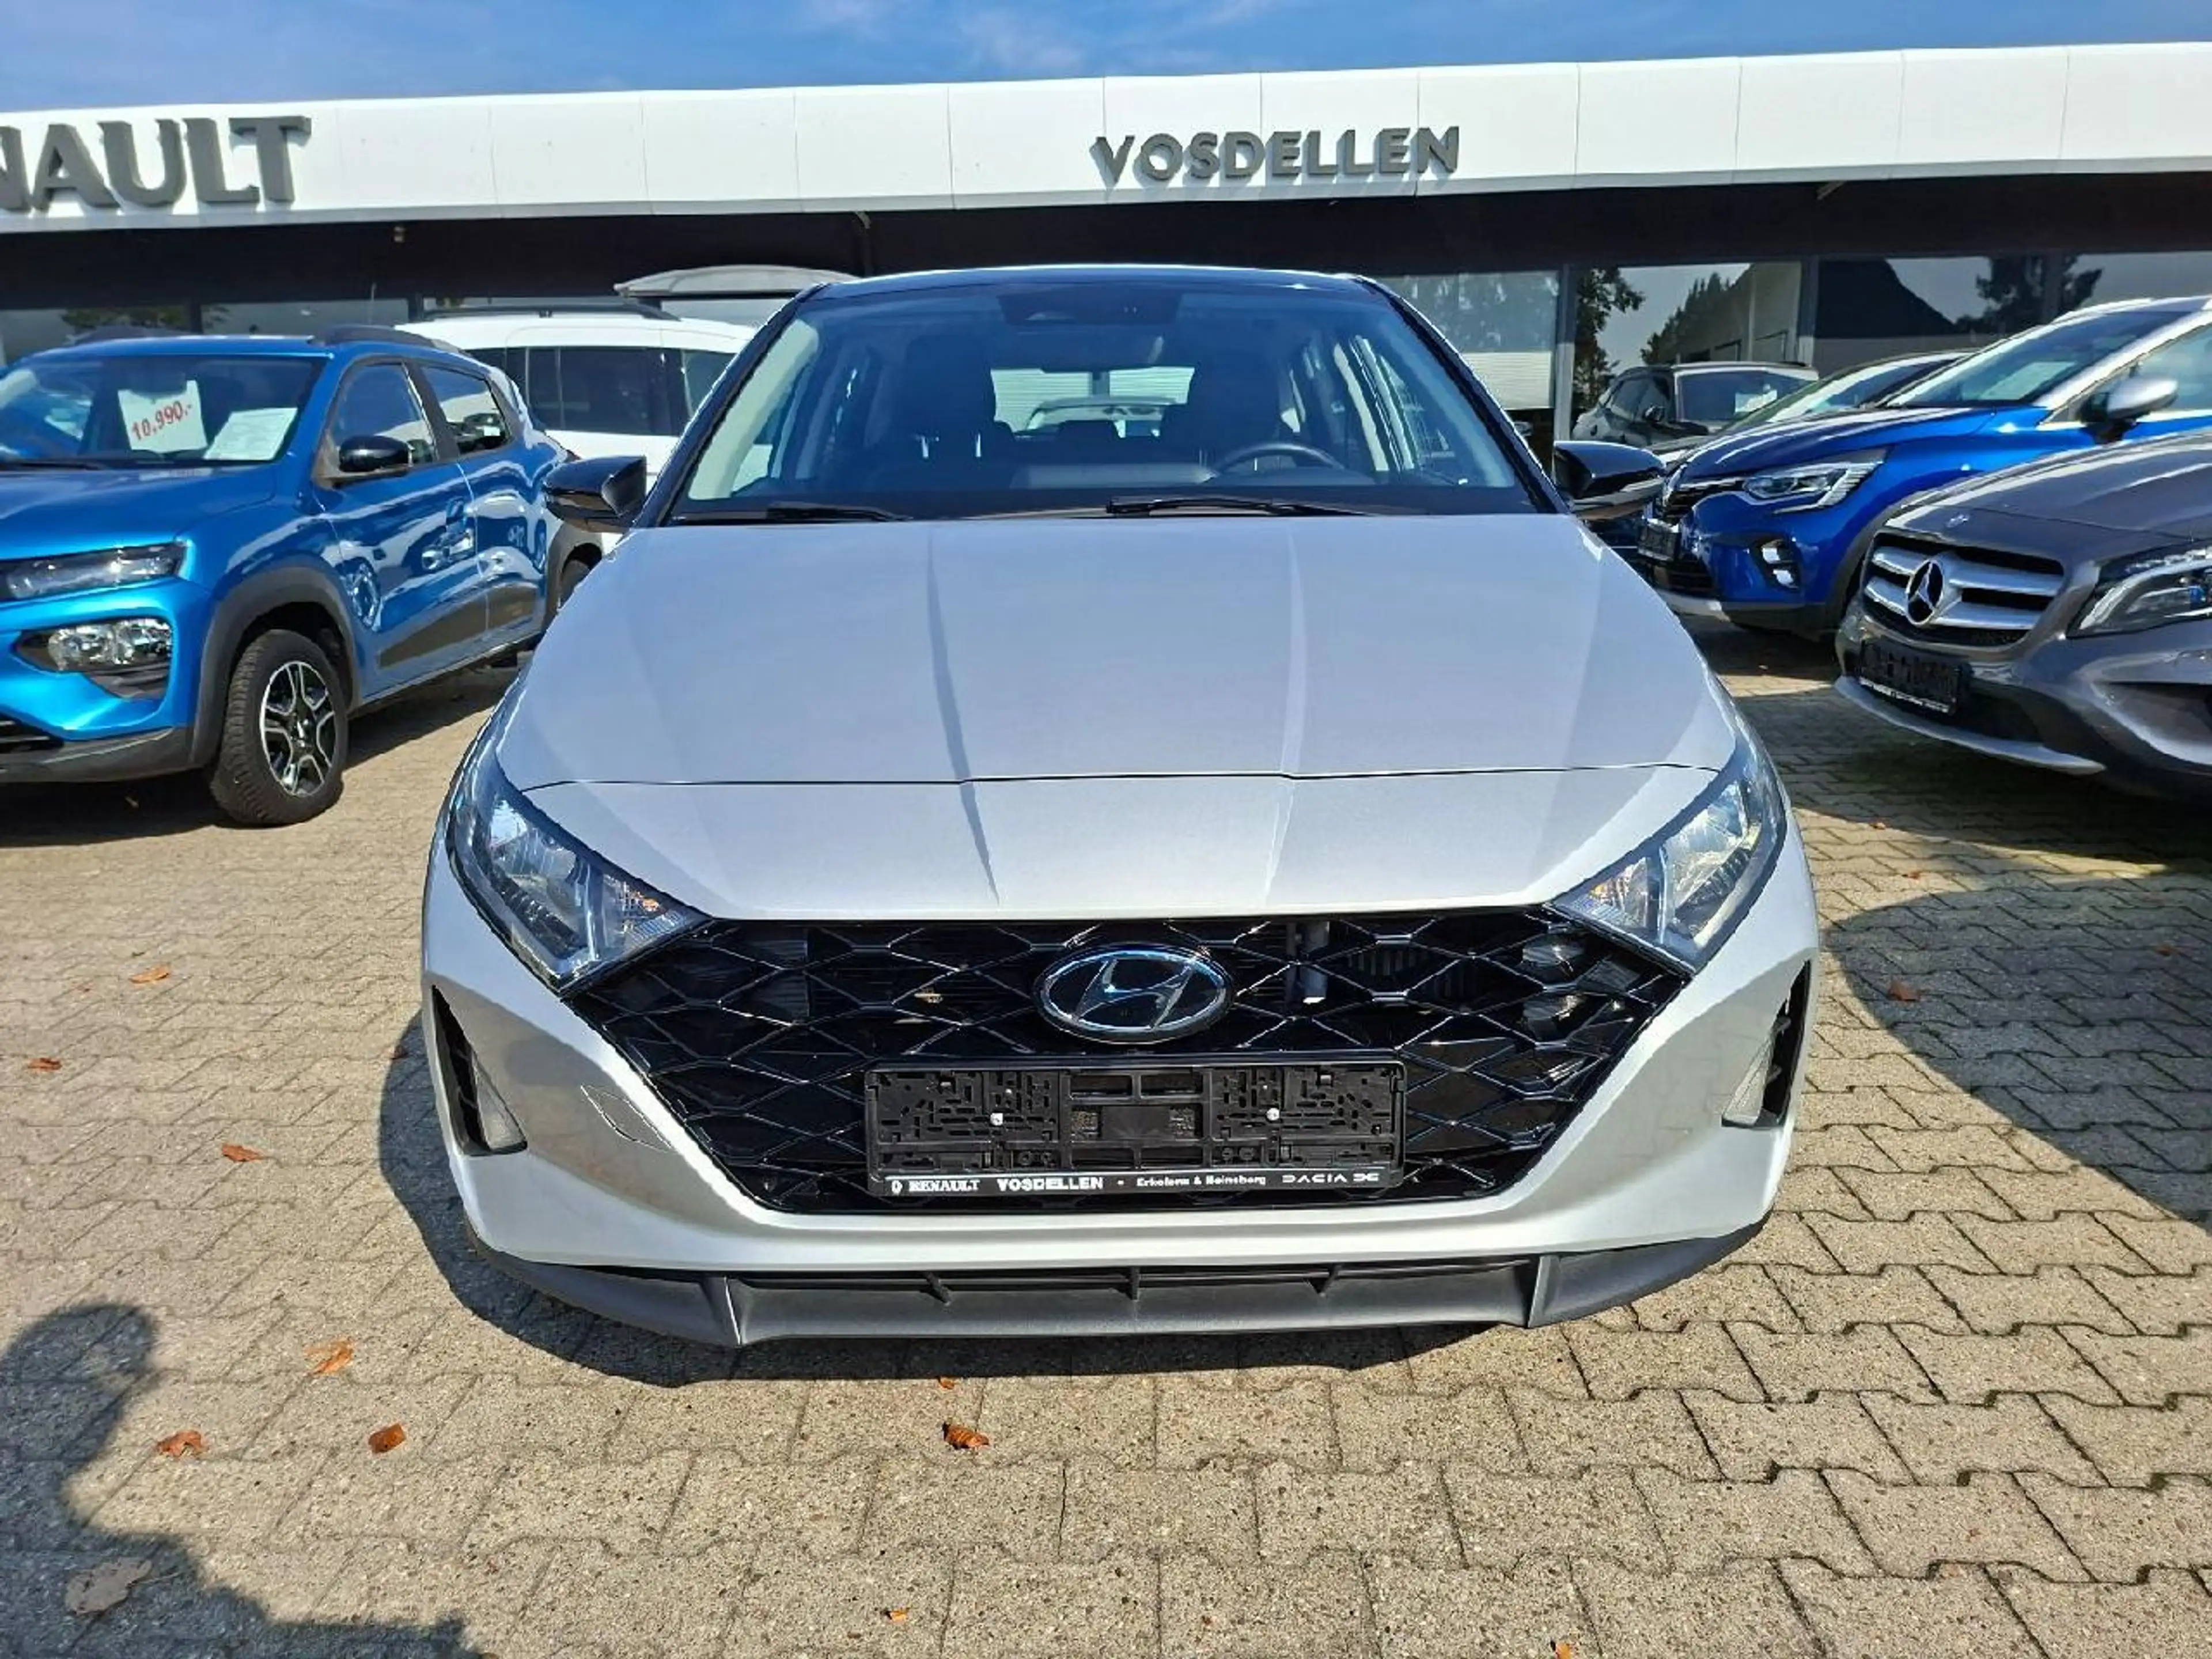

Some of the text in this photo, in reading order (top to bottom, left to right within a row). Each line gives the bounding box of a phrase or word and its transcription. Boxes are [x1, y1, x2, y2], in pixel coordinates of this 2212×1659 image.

[1091, 126, 1460, 185] VOSDELLEN
[908, 1179, 980, 1192] RENAULT
[997, 1177, 1104, 1191] VOSDELLEN
[1282, 1173, 1348, 1183] DACIA
